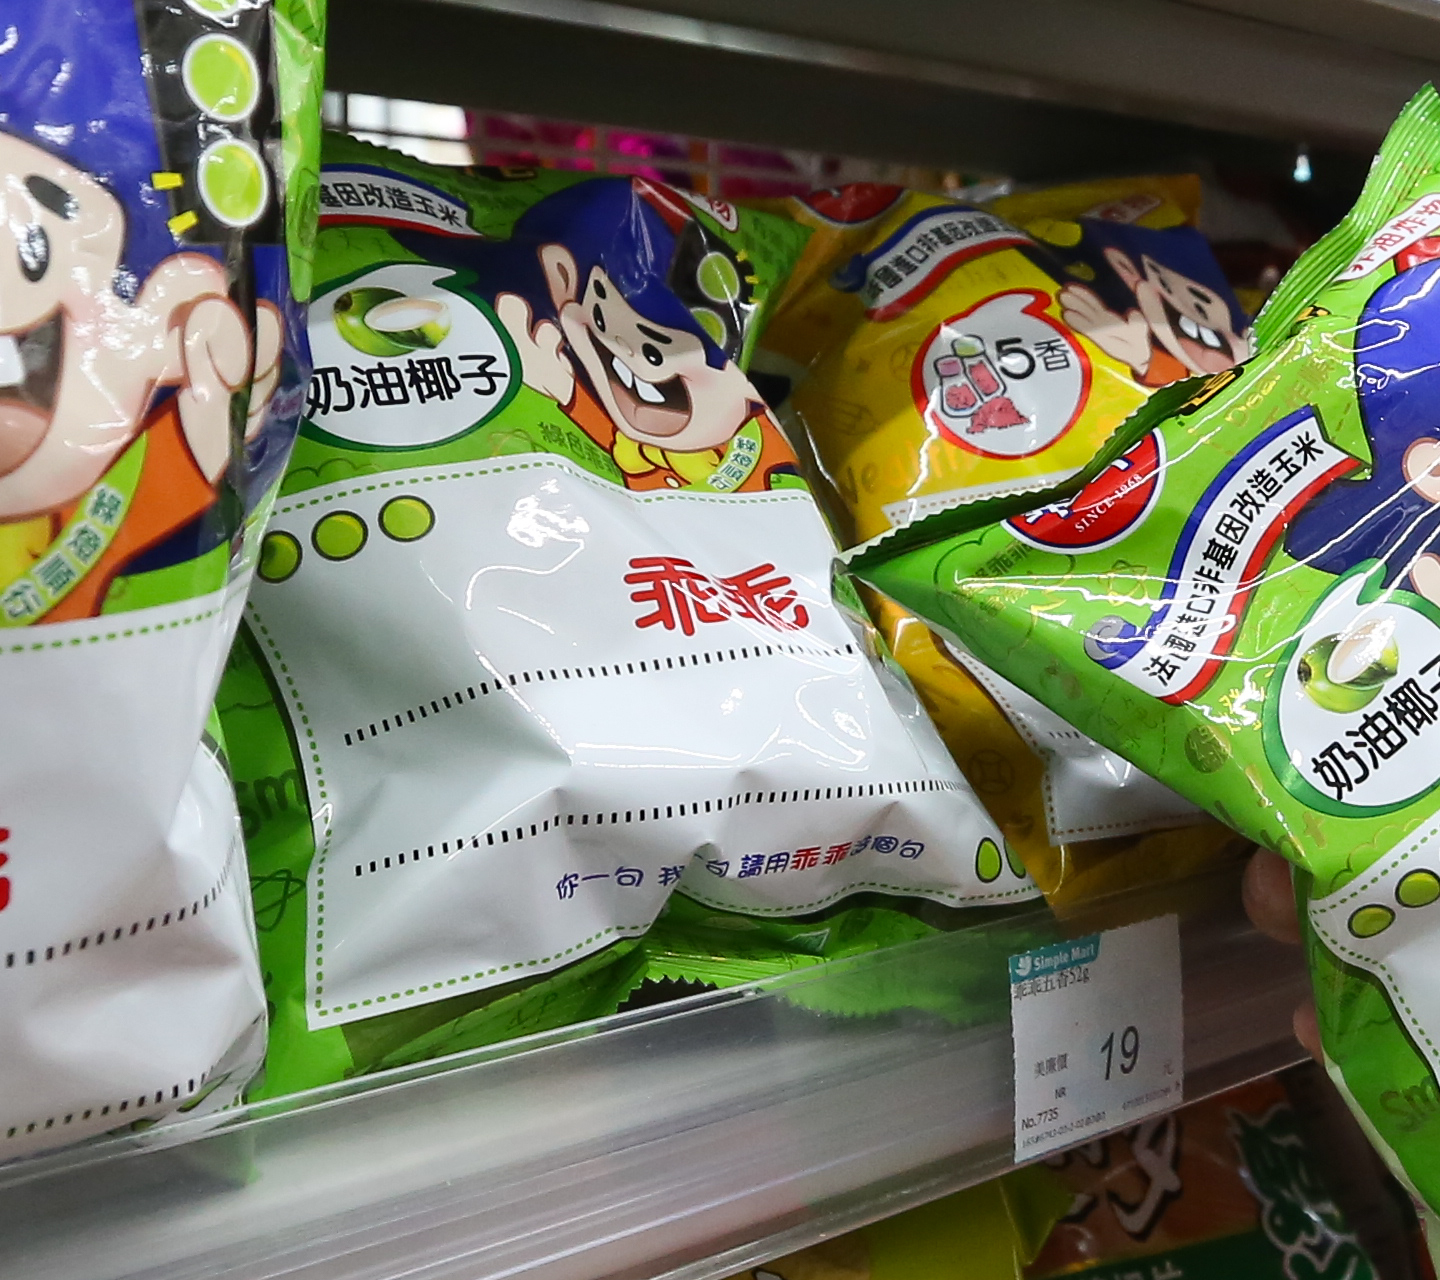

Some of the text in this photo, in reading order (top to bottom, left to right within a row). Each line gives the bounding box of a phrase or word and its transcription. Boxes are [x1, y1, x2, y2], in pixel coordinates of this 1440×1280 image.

[995, 336, 1073, 380] 5香
[304, 352, 509, 419] 奶油椰子
[706, 434, 760, 493] 綠燈順行
[1073, 495, 1113, 534] SINCE
[1112, 472, 1144, 507] 1968
[622, 555, 811, 638] 乖乖
[555, 865, 645, 901] 你一句
[1034, 943, 1094, 970] Simple Mart
[1100, 1025, 1140, 1081] 19
[1054, 1086, 1067, 1100] NR
[1021, 1107, 1059, 1131] No.7735
